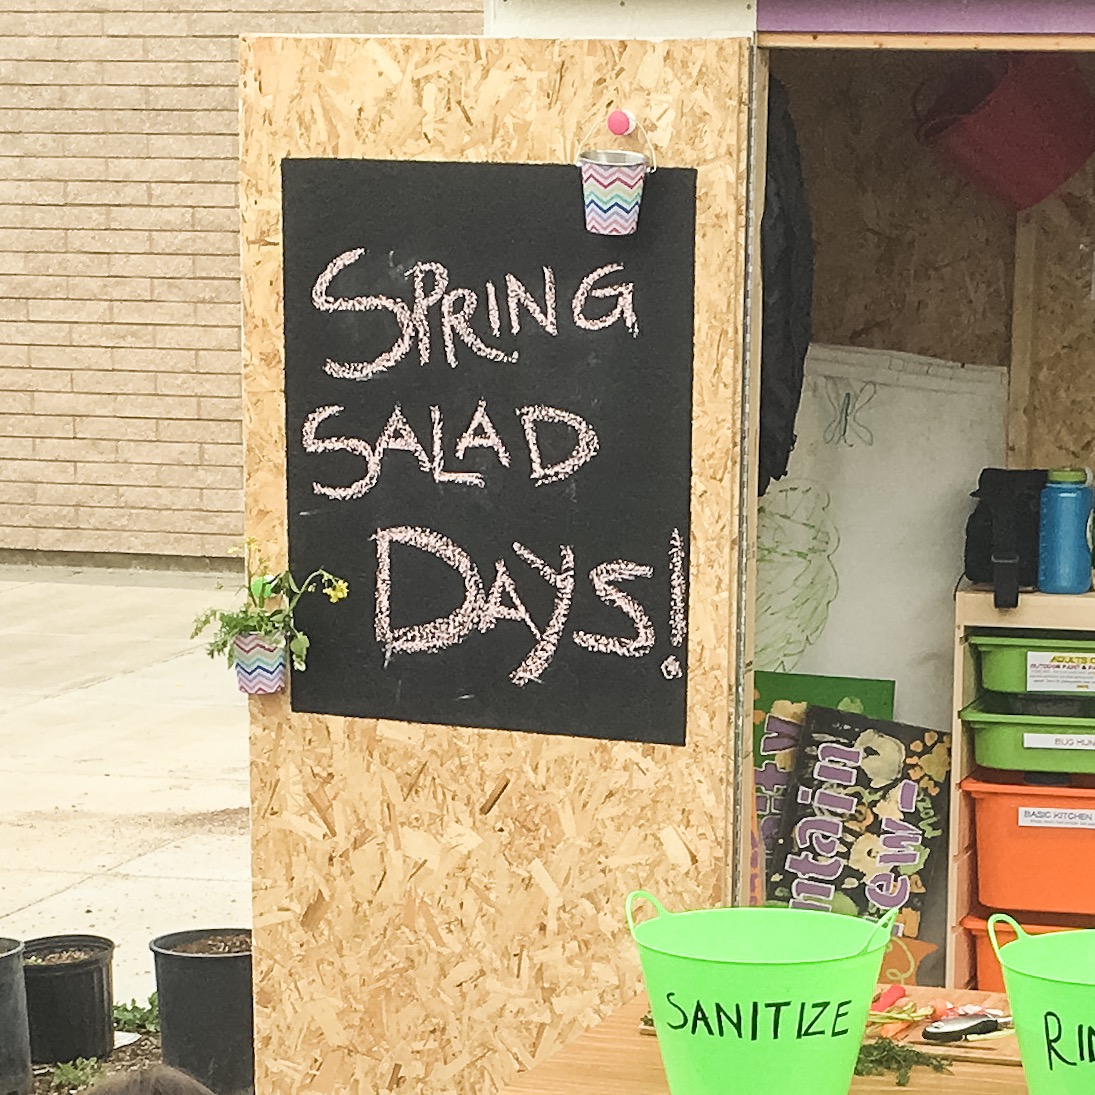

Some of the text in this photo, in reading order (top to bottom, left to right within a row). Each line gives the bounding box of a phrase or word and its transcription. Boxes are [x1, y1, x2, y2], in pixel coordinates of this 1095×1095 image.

[312, 247, 638, 381] SPRING
[302, 398, 601, 500] SALAD
[1054, 738, 1075, 746] BUG
[1024, 810, 1052, 819] BASIC
[1053, 811, 1092, 821] KITCHEN
[666, 992, 853, 1041] SANITIZE
